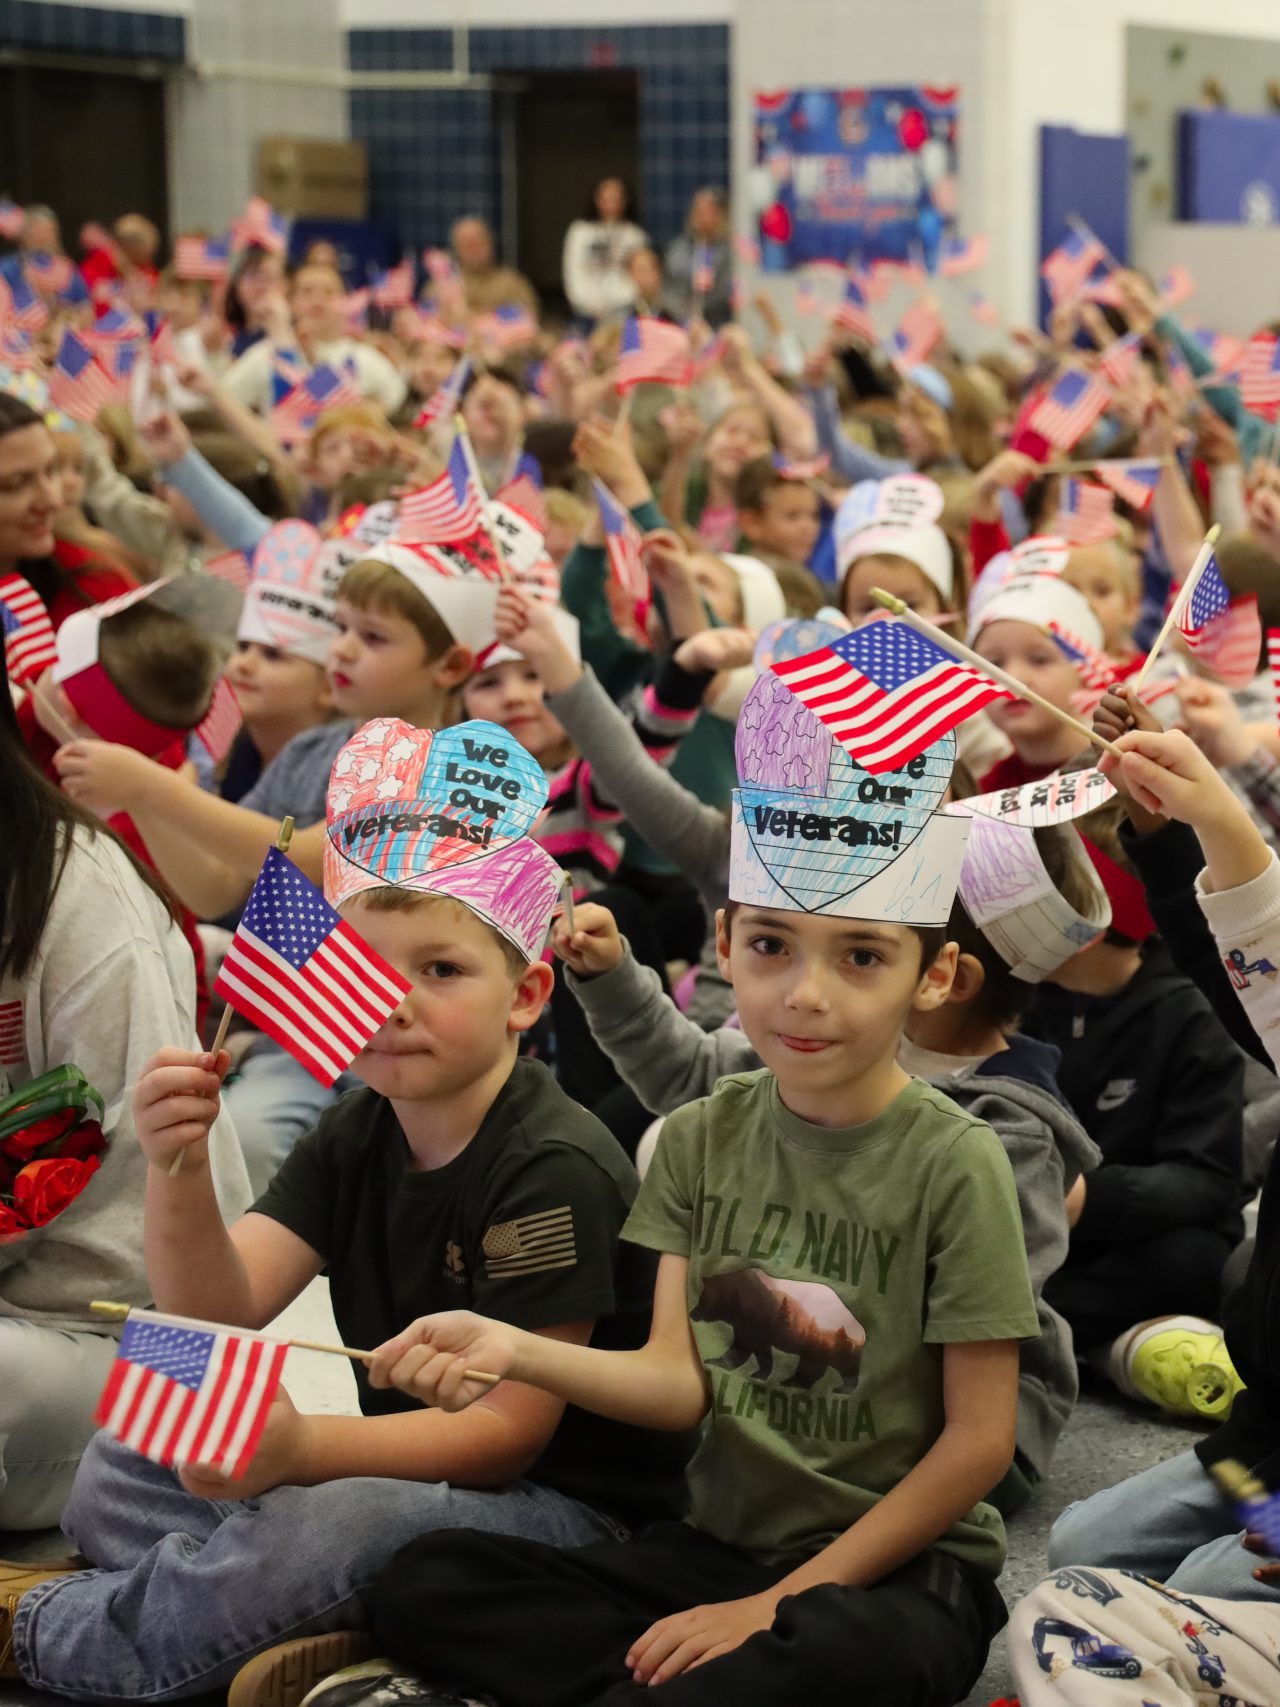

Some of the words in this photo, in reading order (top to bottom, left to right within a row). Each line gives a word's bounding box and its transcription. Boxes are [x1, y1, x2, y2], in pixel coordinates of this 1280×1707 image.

[462, 739, 509, 768] We
[446, 762, 521, 800] Love
[858, 777, 912, 806] Our
[450, 788, 505, 820] Our
[755, 805, 902, 851] Veterans!
[794, 1210, 901, 1295] NAVY
[716, 1373, 878, 1442] LIFORNIA
